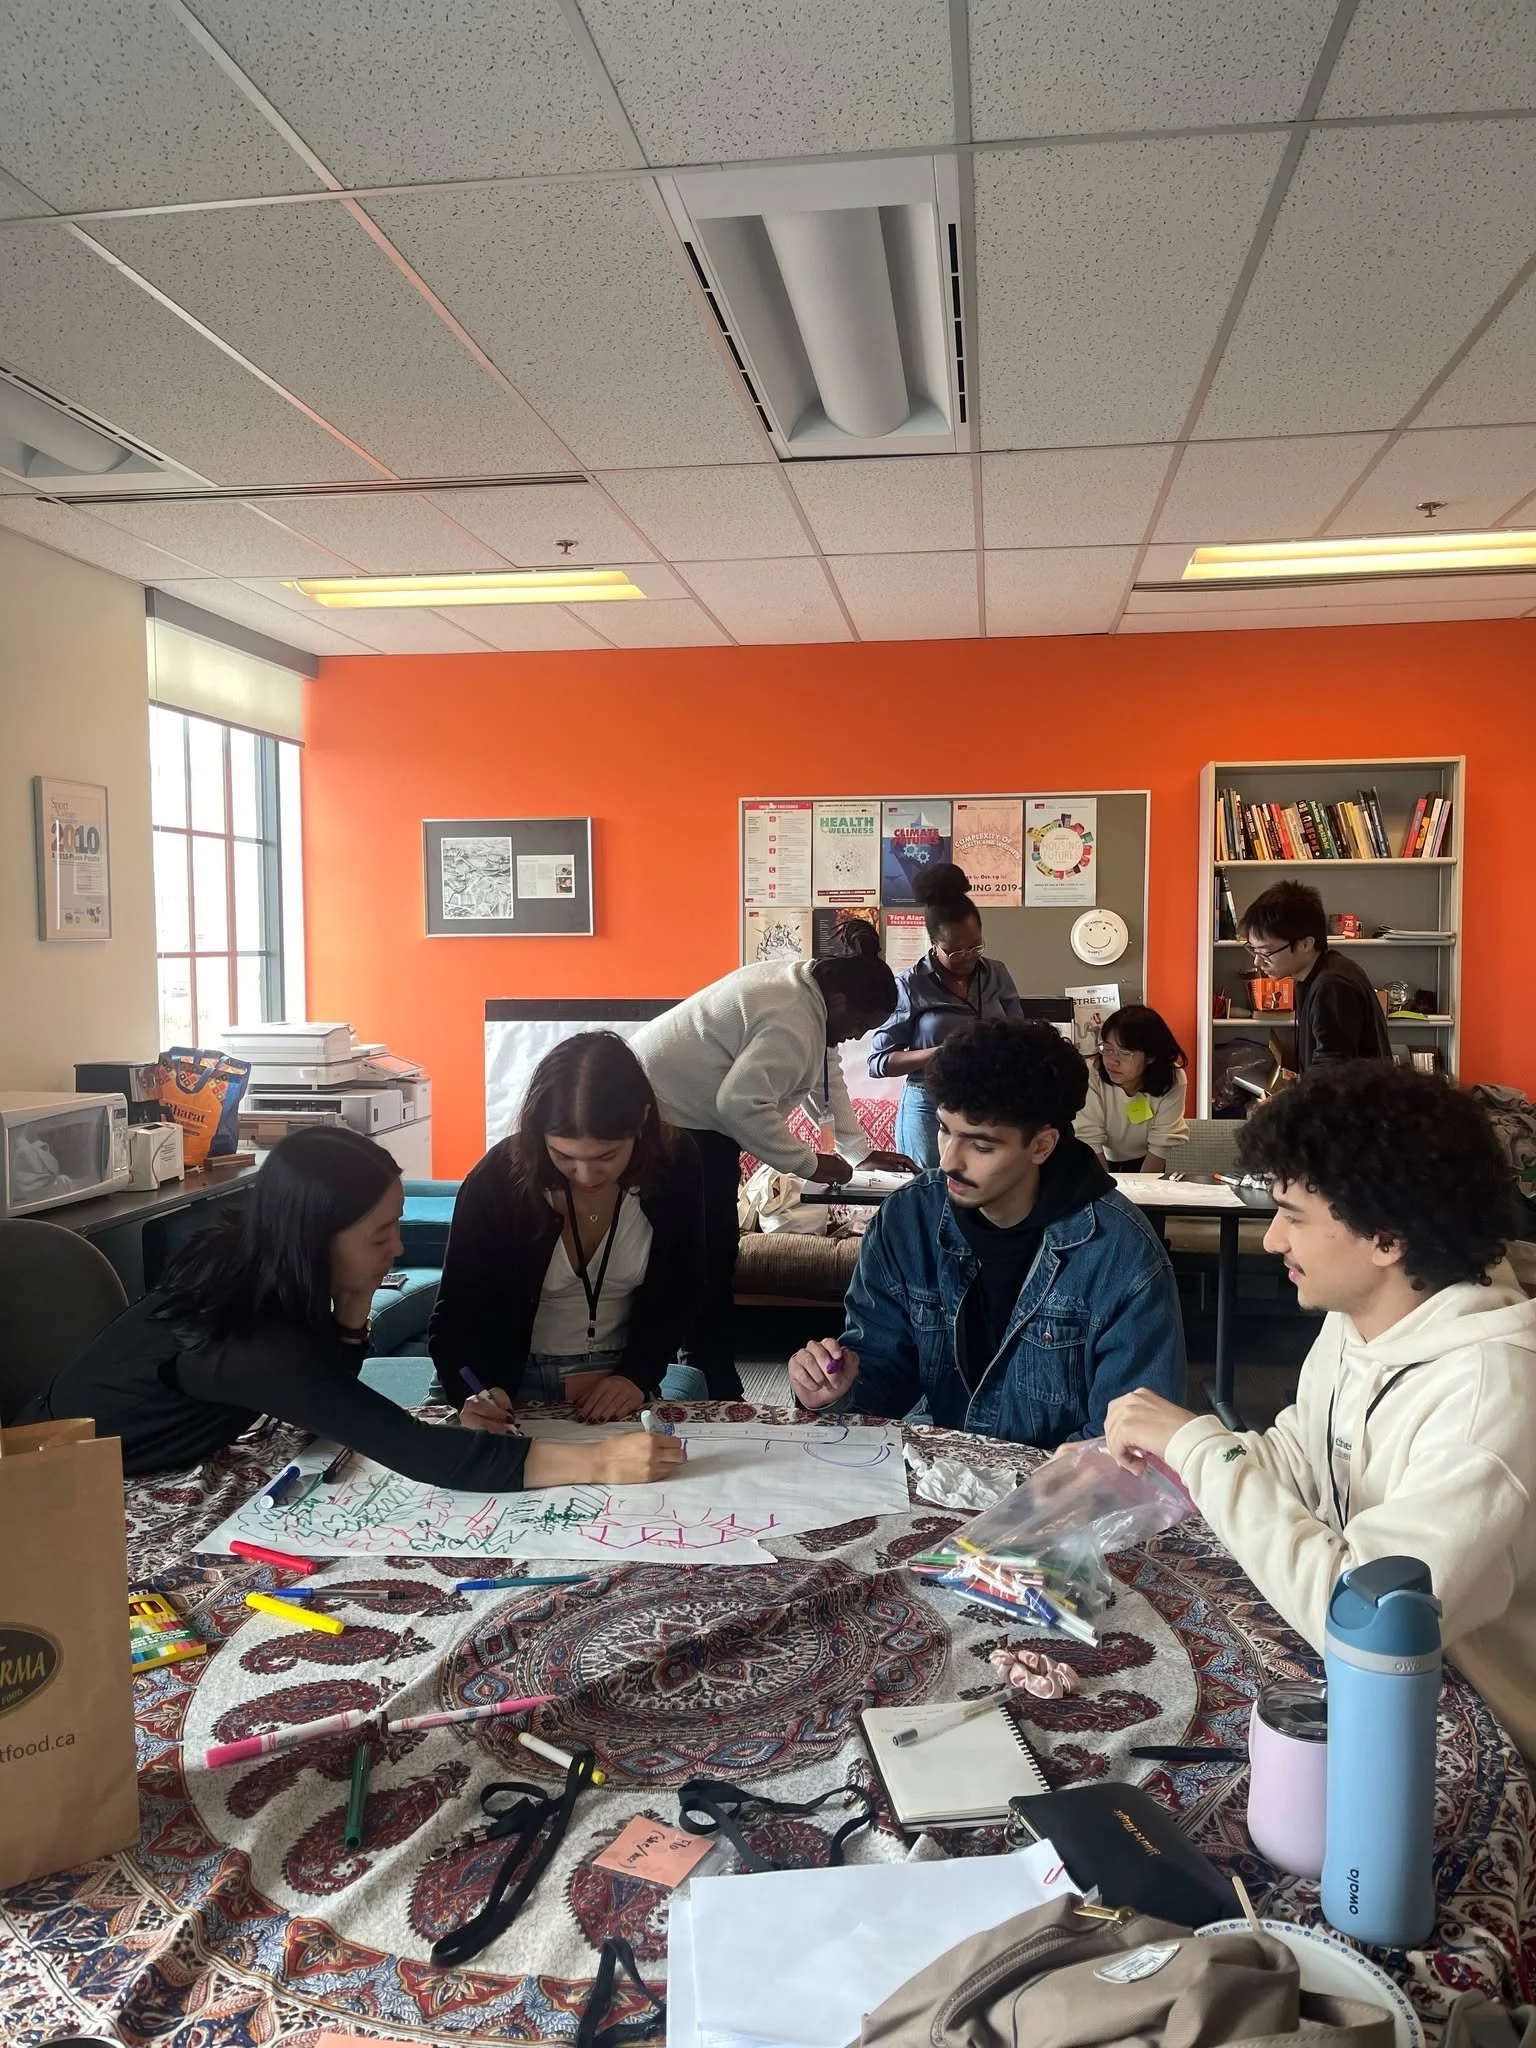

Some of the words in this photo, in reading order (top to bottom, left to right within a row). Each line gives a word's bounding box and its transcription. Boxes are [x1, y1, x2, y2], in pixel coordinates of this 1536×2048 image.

[820, 816, 875, 828] HEALTH
[894, 828, 940, 837] CLIMATE
[51, 823, 100, 854] 2010
[954, 832, 1001, 848] COMPLEXITY
[1001, 836, 1013, 844] OF
[960, 840, 981, 851] HEALTH
[1042, 840, 1082, 851] HOUSING
[1043, 851, 1080, 861] FUTURES
[995, 884, 1018, 892] 2019
[1072, 996, 1116, 1006] STRETCH
[0, 1651, 46, 1688] RMA
[1347, 1868, 1360, 1915] owala
